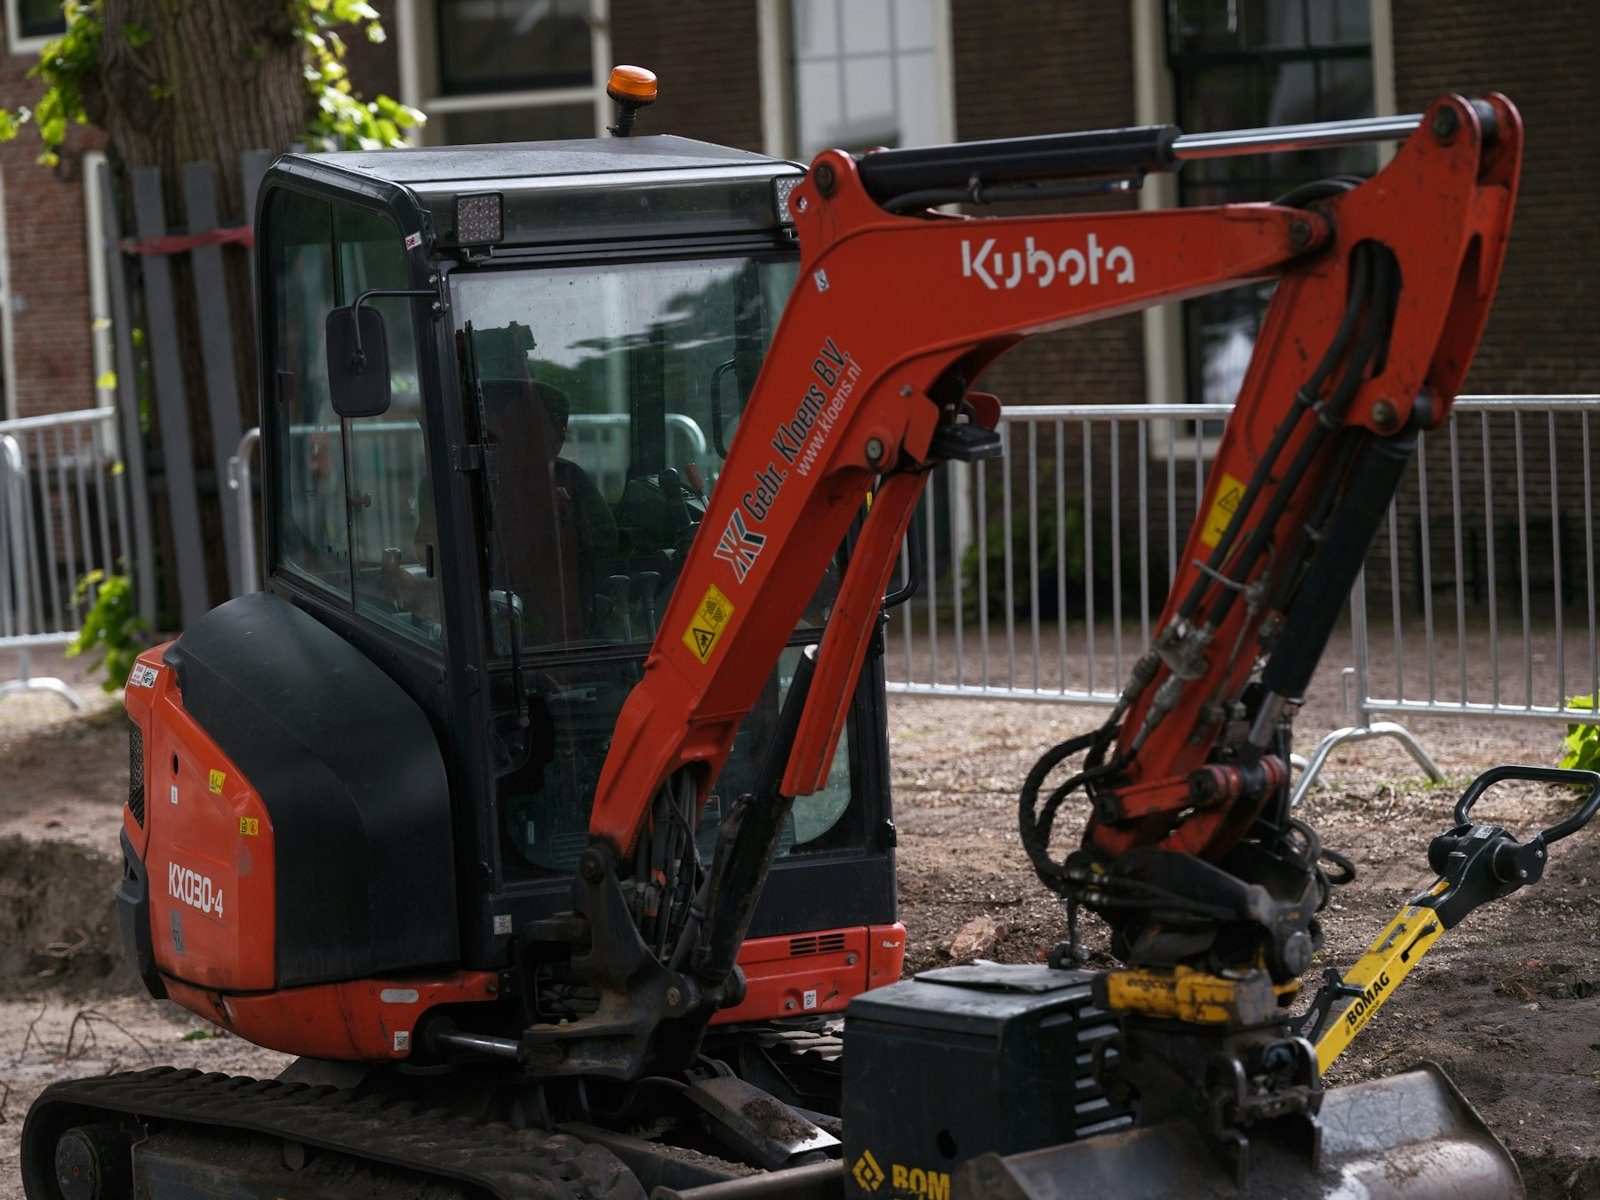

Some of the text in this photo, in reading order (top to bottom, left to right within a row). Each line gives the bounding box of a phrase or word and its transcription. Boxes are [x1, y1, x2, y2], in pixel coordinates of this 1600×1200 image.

[961, 233, 1135, 289] Kubota
[741, 336, 850, 522] Gebr. Kloens B.V.
[796, 358, 862, 478] www.kloens.nl
[168, 861, 223, 918] KX030-4
[1346, 972, 1390, 1026] BOMAG
